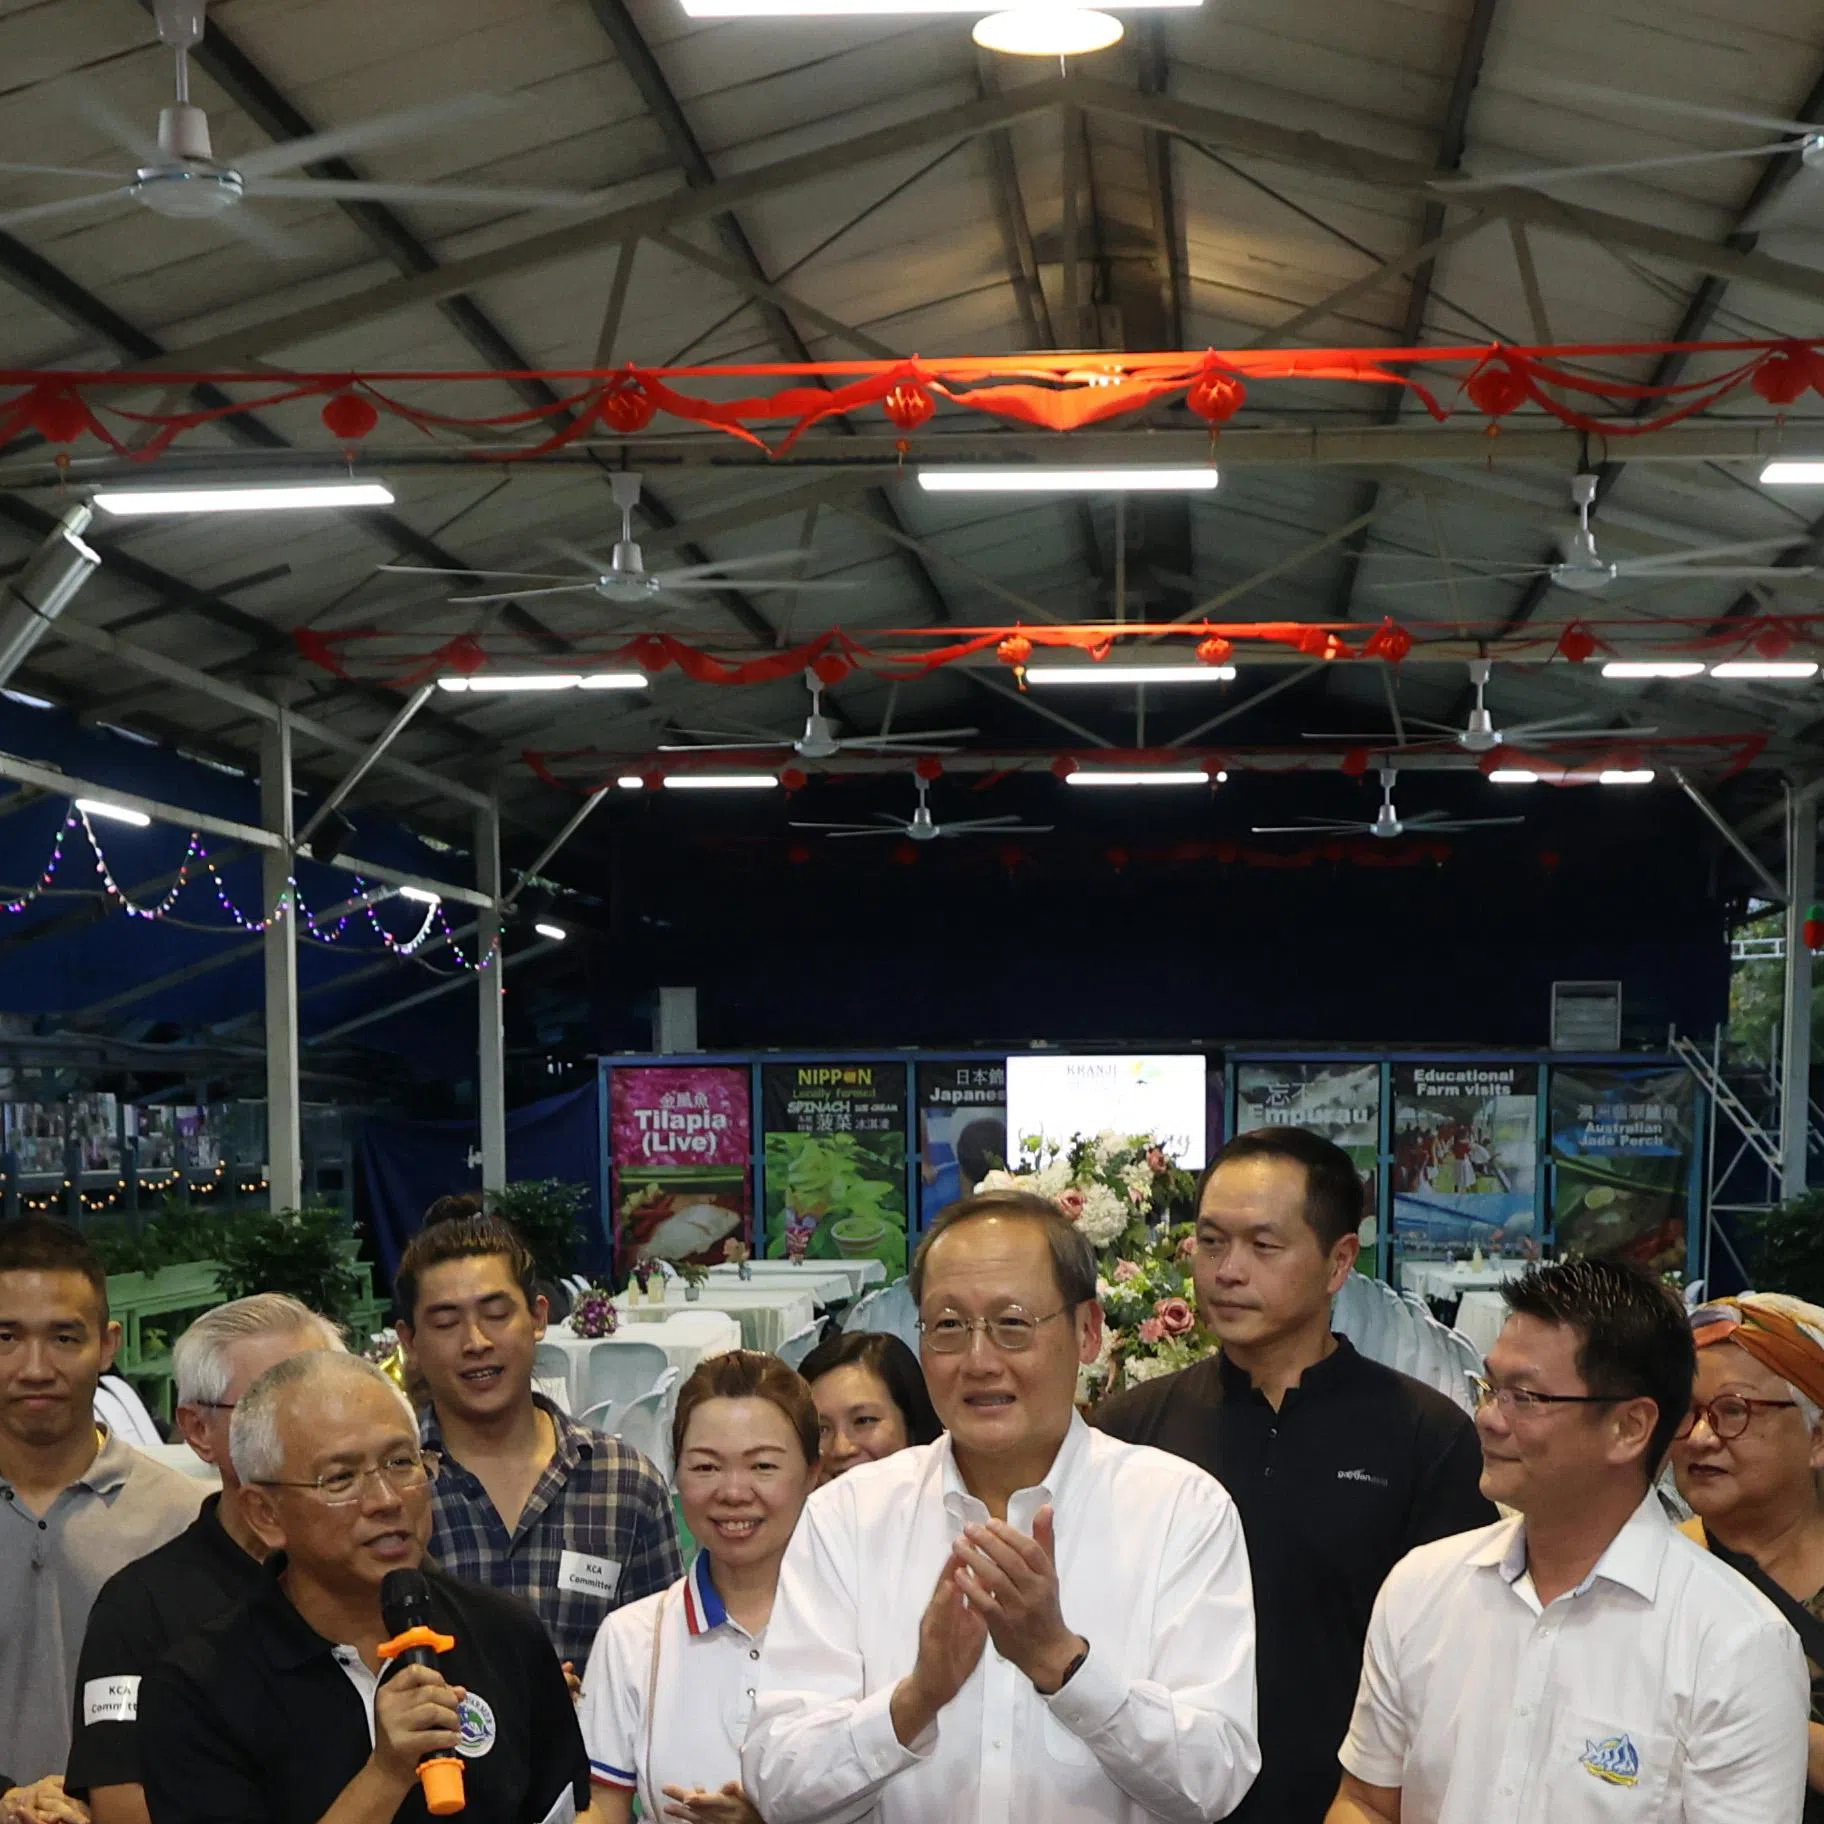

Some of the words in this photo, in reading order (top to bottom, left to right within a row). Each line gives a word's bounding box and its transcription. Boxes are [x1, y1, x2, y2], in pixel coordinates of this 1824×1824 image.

[798, 1068, 873, 1085] NIPPON
[1066, 1064, 1116, 1077] KRANJI
[1414, 1068, 1515, 1083] Educational
[1417, 1083, 1461, 1097] Farm
[787, 1101, 850, 1114] SPINACH
[634, 1109, 727, 1131] Tilapia
[1586, 1122, 1663, 1134] Australian
[642, 1132, 717, 1157] (Live)
[586, 1563, 603, 1575] KCA
[569, 1574, 613, 1591] Committee
[108, 1686, 131, 1696] KCA
